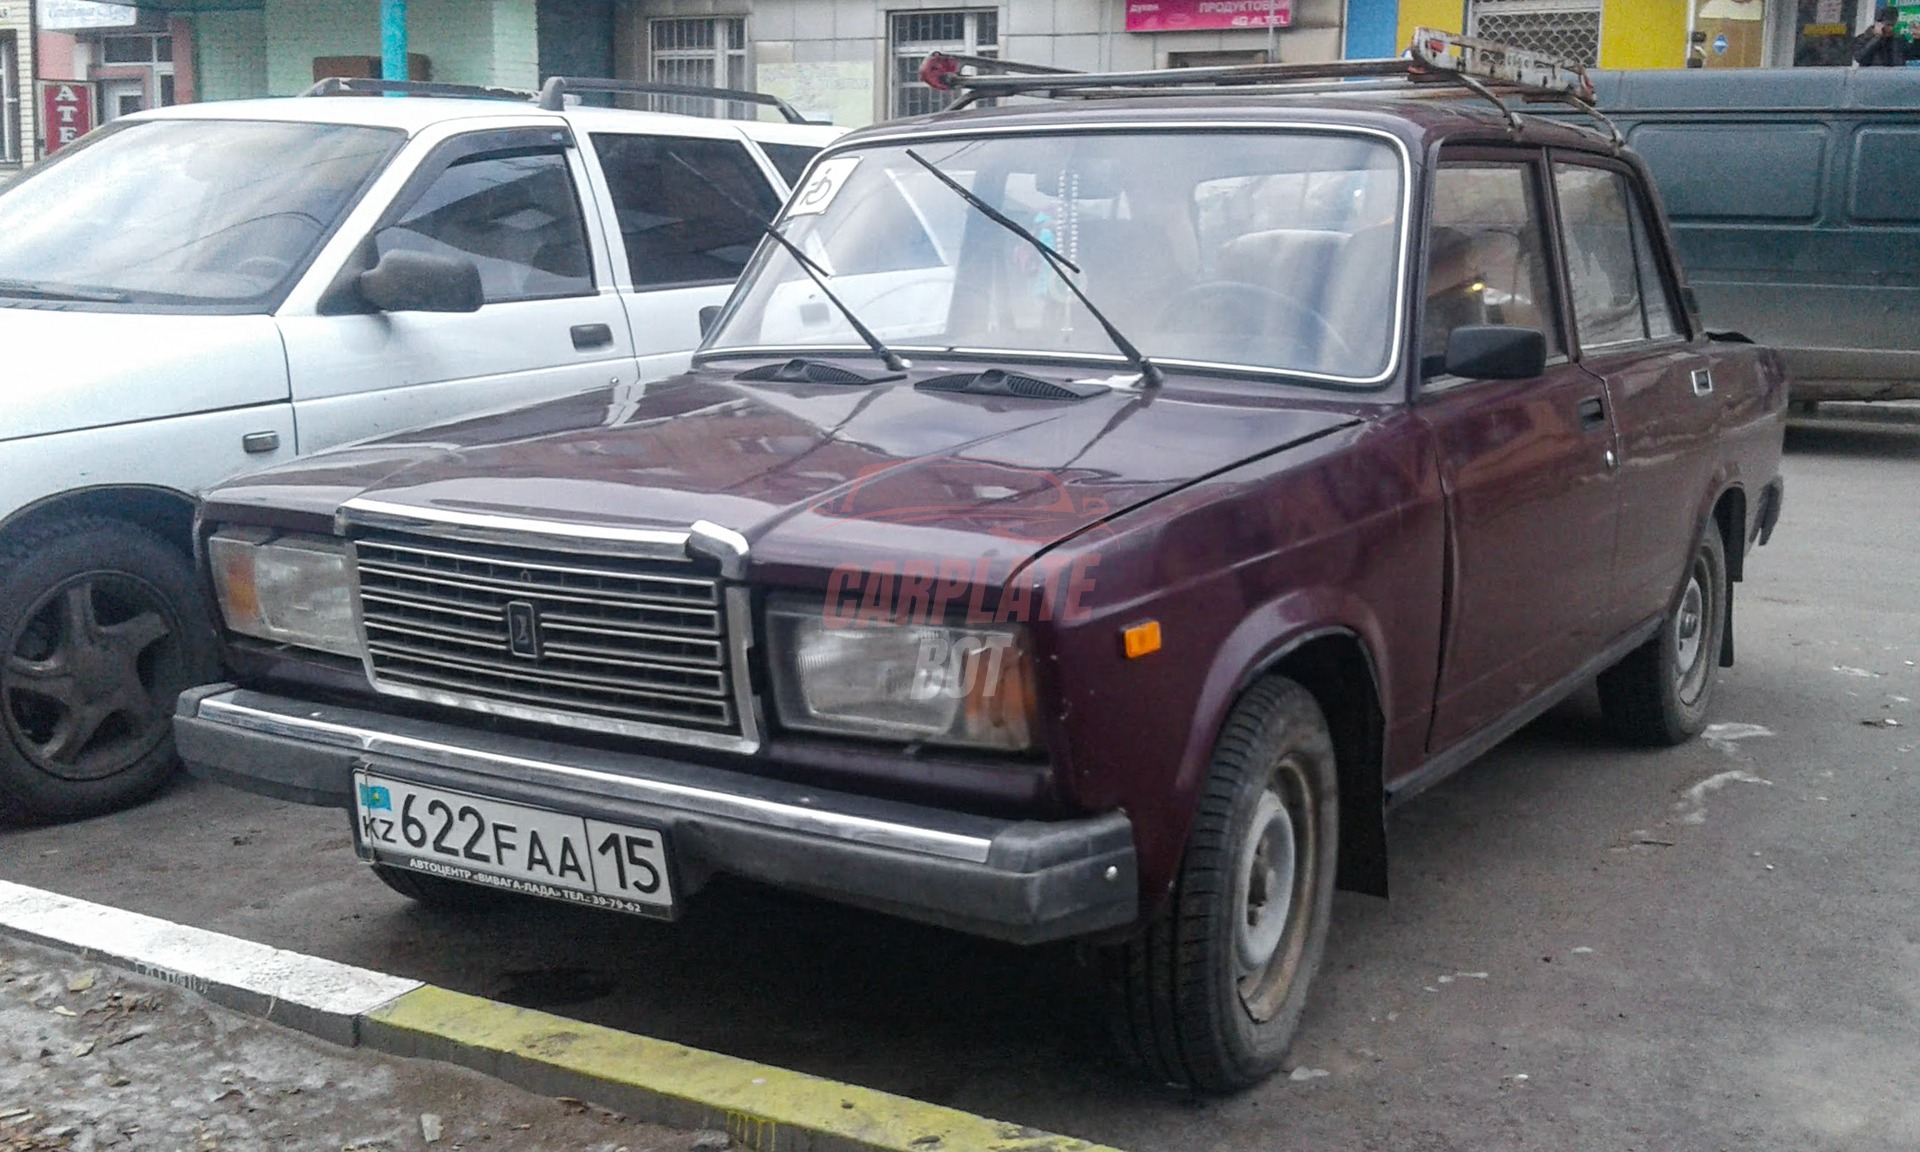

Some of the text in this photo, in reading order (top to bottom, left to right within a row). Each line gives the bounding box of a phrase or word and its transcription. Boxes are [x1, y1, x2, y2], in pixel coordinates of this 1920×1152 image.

[362, 815, 397, 844] KZ
[410, 858, 472, 878] АВТОЦЕНТР
[592, 894, 641, 913] 39-79-62
[598, 832, 660, 894] 15
